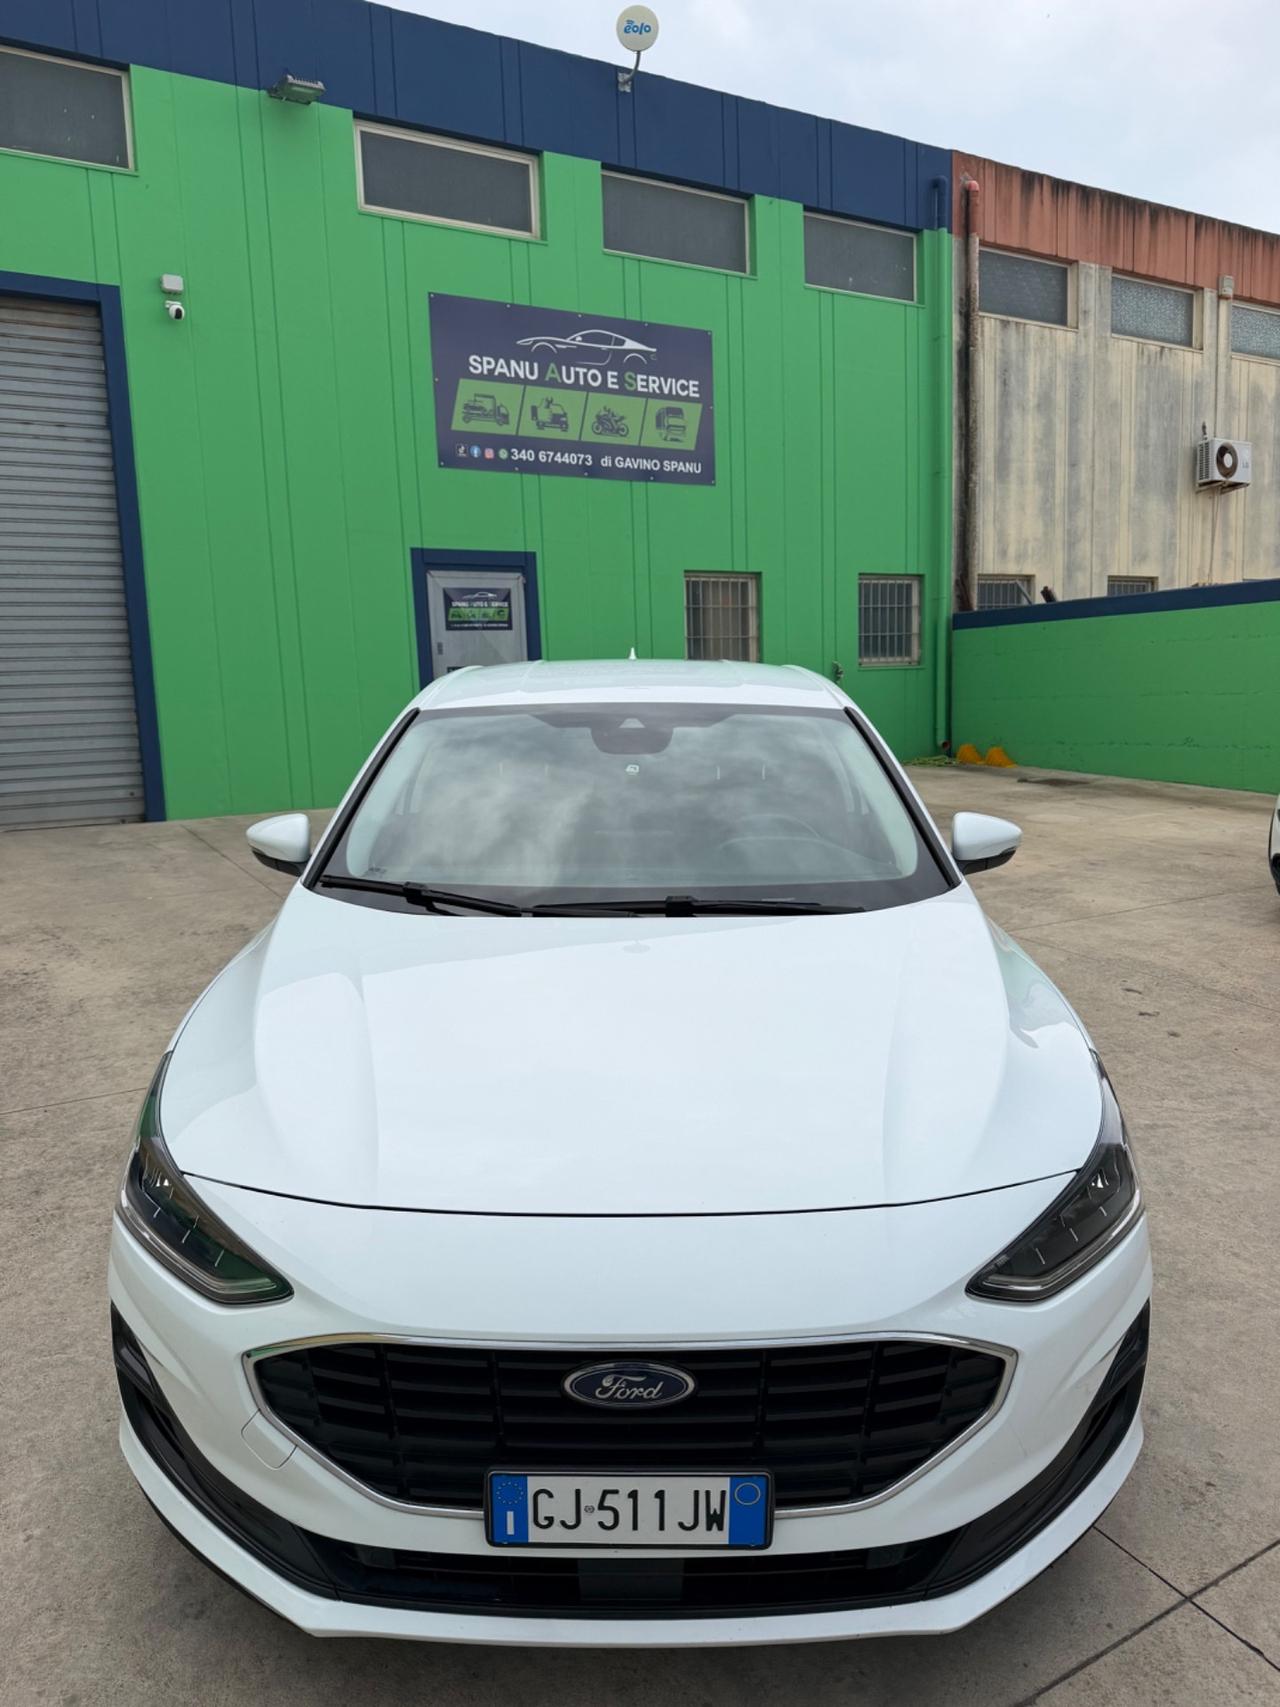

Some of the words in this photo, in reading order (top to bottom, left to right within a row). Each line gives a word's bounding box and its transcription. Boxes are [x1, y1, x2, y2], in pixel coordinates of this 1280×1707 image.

[468, 354, 539, 380] SPANU
[545, 362, 602, 387] AUTO
[607, 371, 620, 389] E
[624, 371, 700, 398] SERVICE
[510, 448, 535, 461] 340
[538, 450, 593, 466] 6744073
[600, 455, 612, 467] di
[614, 456, 661, 471] GAVINO
[663, 460, 702, 474] SPANU
[595, 1374, 665, 1400] Ford
